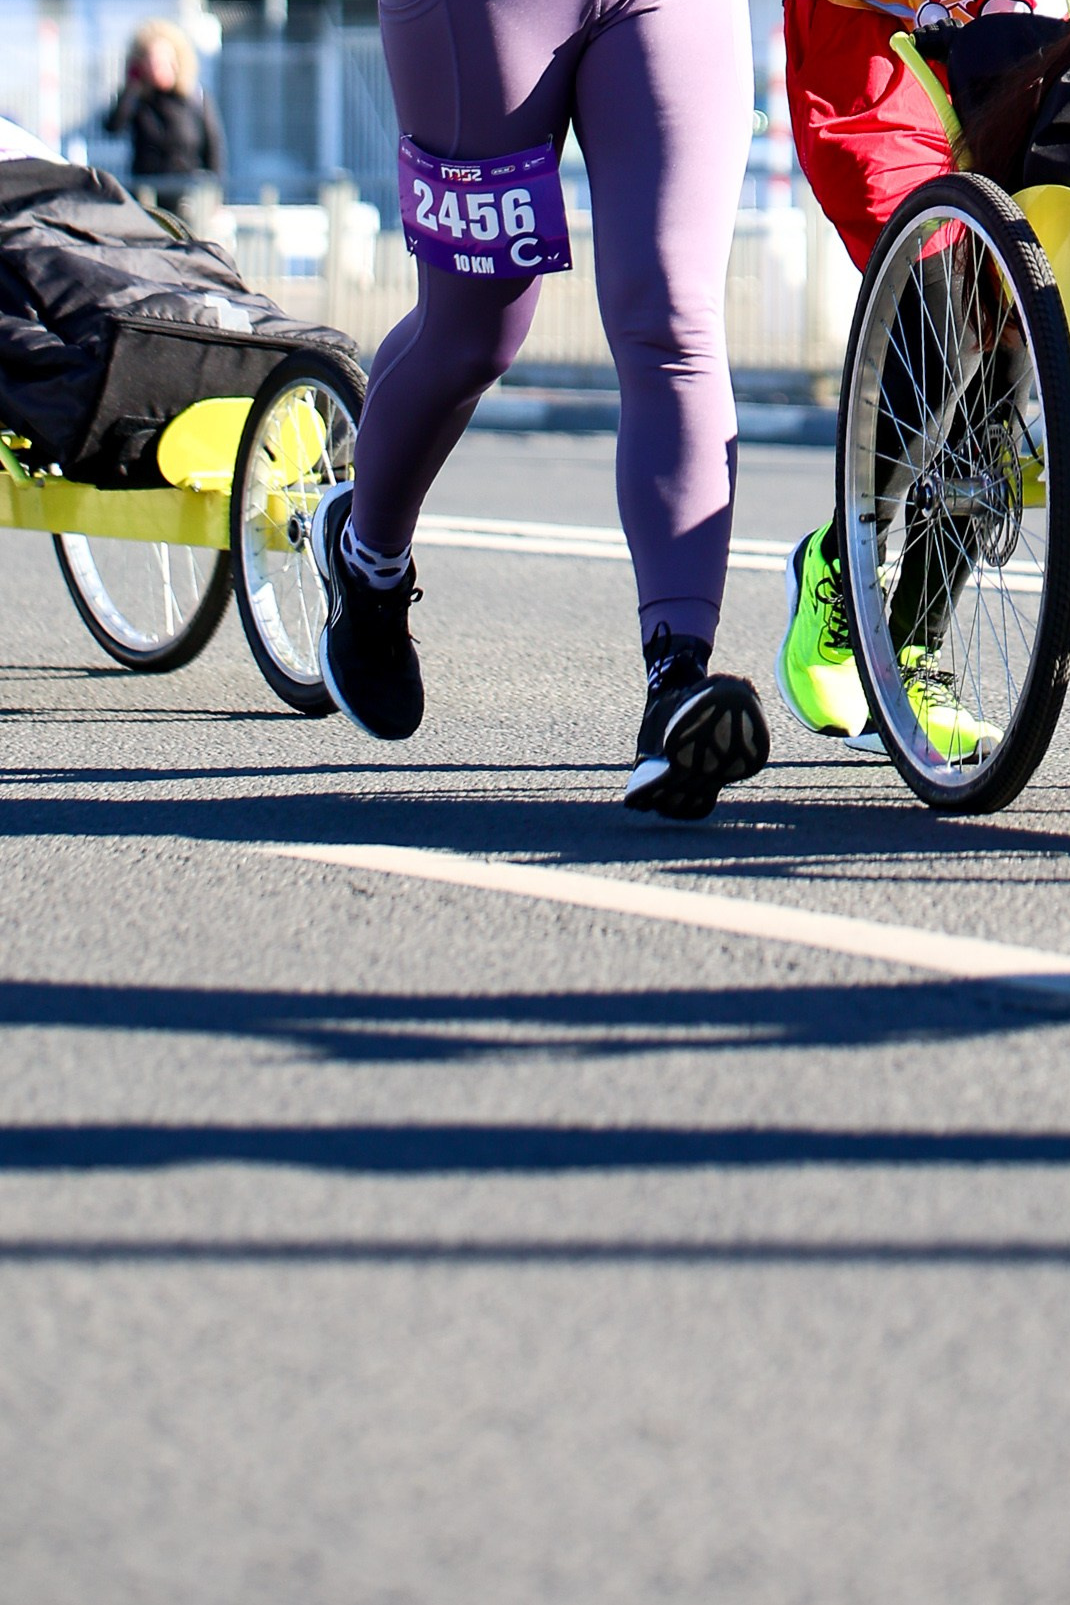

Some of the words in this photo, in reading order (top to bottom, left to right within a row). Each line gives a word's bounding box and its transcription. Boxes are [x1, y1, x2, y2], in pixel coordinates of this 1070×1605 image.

[413, 178, 536, 241] 2456
[453, 253, 470, 273] 10
[471, 254, 495, 274] KM
[510, 237, 543, 267] C
